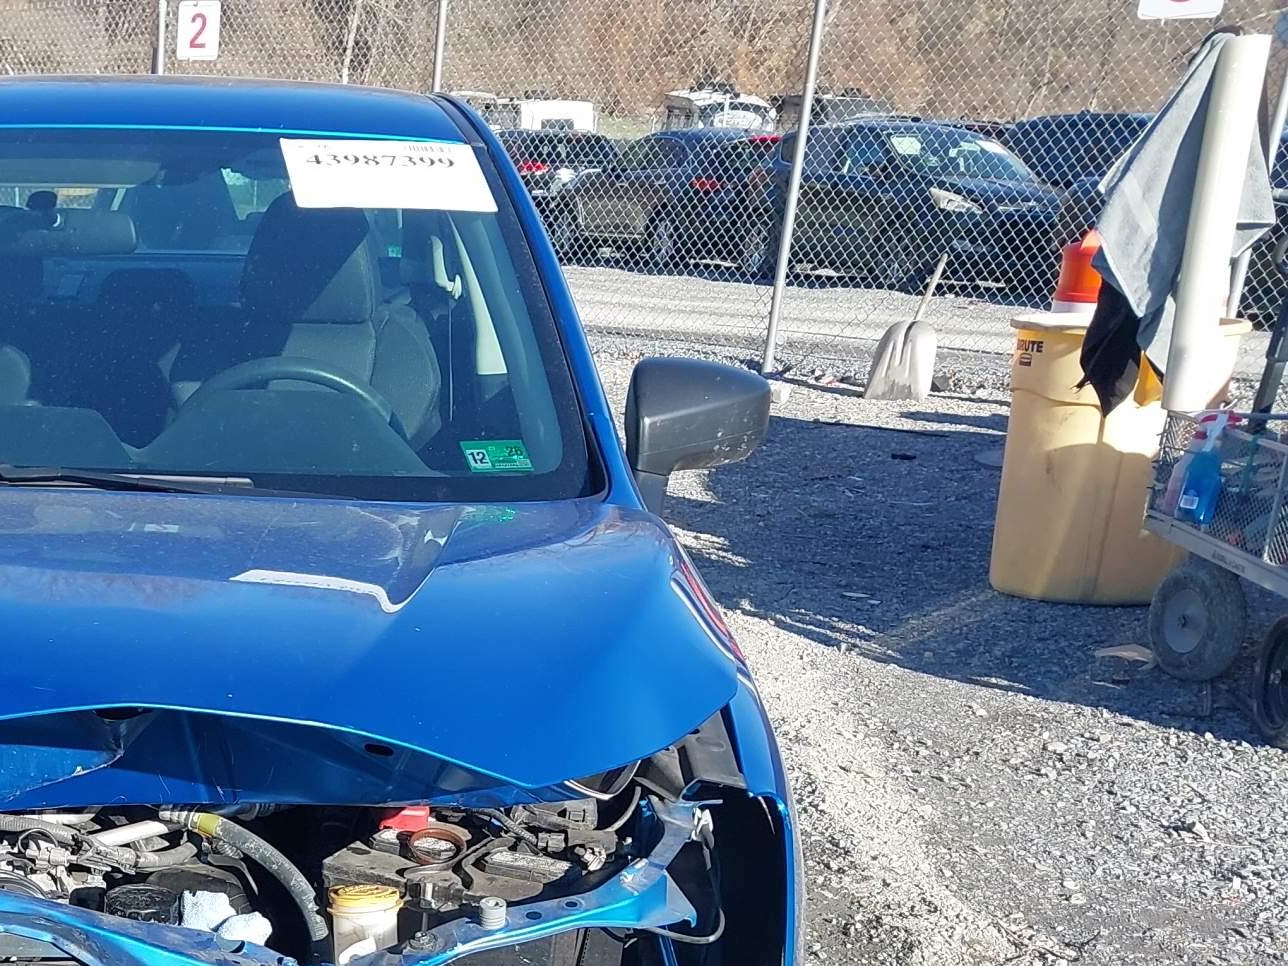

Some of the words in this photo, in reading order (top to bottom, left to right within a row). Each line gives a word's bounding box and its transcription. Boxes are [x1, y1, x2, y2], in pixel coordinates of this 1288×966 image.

[189, 12, 207, 49] 2
[306, 153, 455, 169] 43987399
[467, 451, 489, 465] 12
